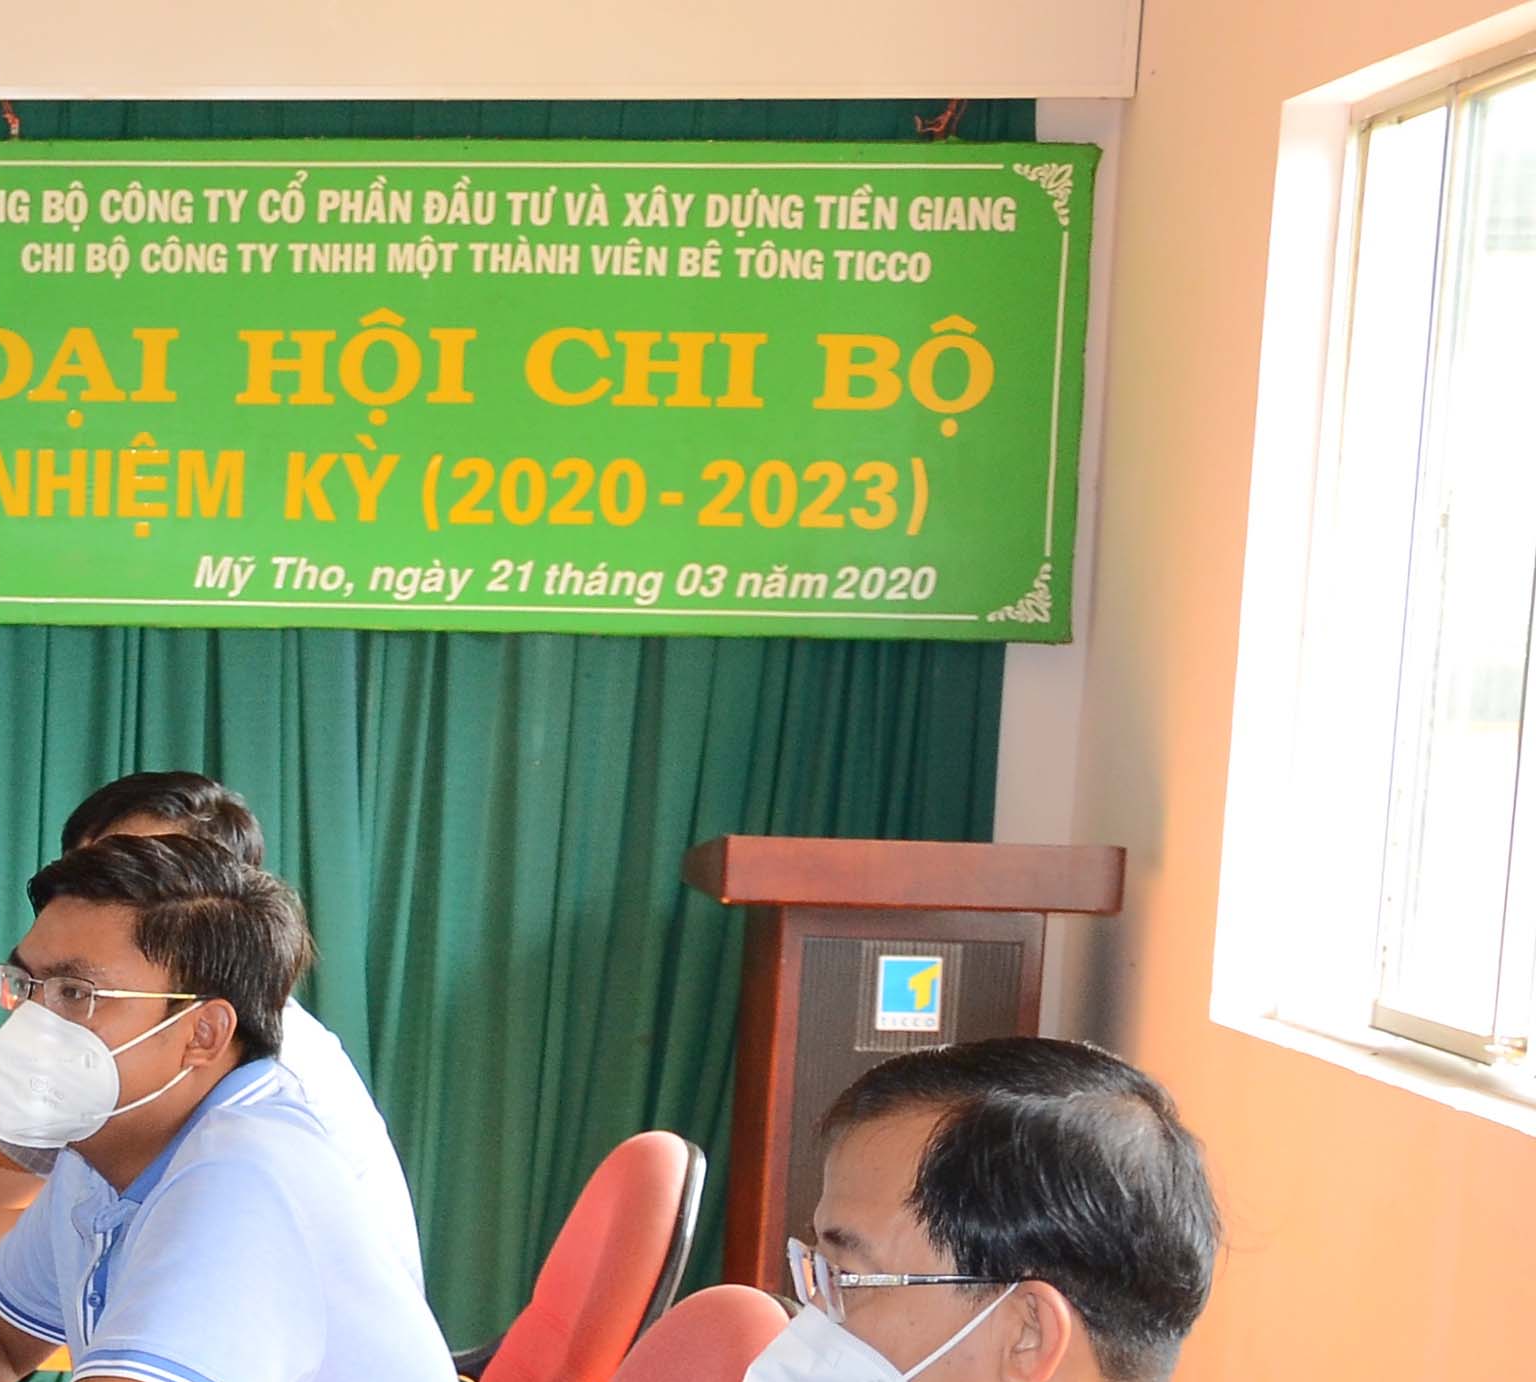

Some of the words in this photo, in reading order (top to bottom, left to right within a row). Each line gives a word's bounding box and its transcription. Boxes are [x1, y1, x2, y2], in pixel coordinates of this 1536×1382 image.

[41, 180, 89, 232] BỘ
[99, 180, 194, 224] CÔNG
[202, 188, 248, 223] TY
[257, 169, 309, 224] CỔ
[317, 175, 413, 225] PHẦN
[422, 175, 497, 226] ĐẦU
[506, 185, 558, 227] TƯ
[564, 183, 610, 227] VÀ
[622, 184, 695, 228] XÂY
[705, 187, 805, 238] DỰNG
[814, 183, 899, 231] TIỀN
[908, 196, 1017, 232] GIANG
[20, 242, 75, 273] CHI
[85, 235, 130, 279] BỘ
[140, 234, 228, 274] CÔNG
[236, 242, 279, 273] TY
[287, 242, 376, 274] TNHH
[386, 234, 460, 279] MỘT
[468, 235, 581, 275] THÀNH
[591, 237, 669, 277] VIÊN
[677, 239, 723, 278] BÊ
[734, 239, 825, 281] TÔNG
[833, 249, 932, 283] TICCO
[235, 307, 478, 427] HỘI
[524, 327, 769, 409] CHI
[812, 314, 995, 438] BỘ
[283, 433, 401, 523] KỲ
[193, 554, 257, 599] Mỹ
[271, 555, 355, 597] Tho,
[368, 559, 474, 603] ngày
[485, 558, 535, 593] 21
[543, 561, 665, 605] tháng
[675, 562, 729, 598] 03
[735, 565, 829, 599] năm
[832, 565, 937, 601] 2020
